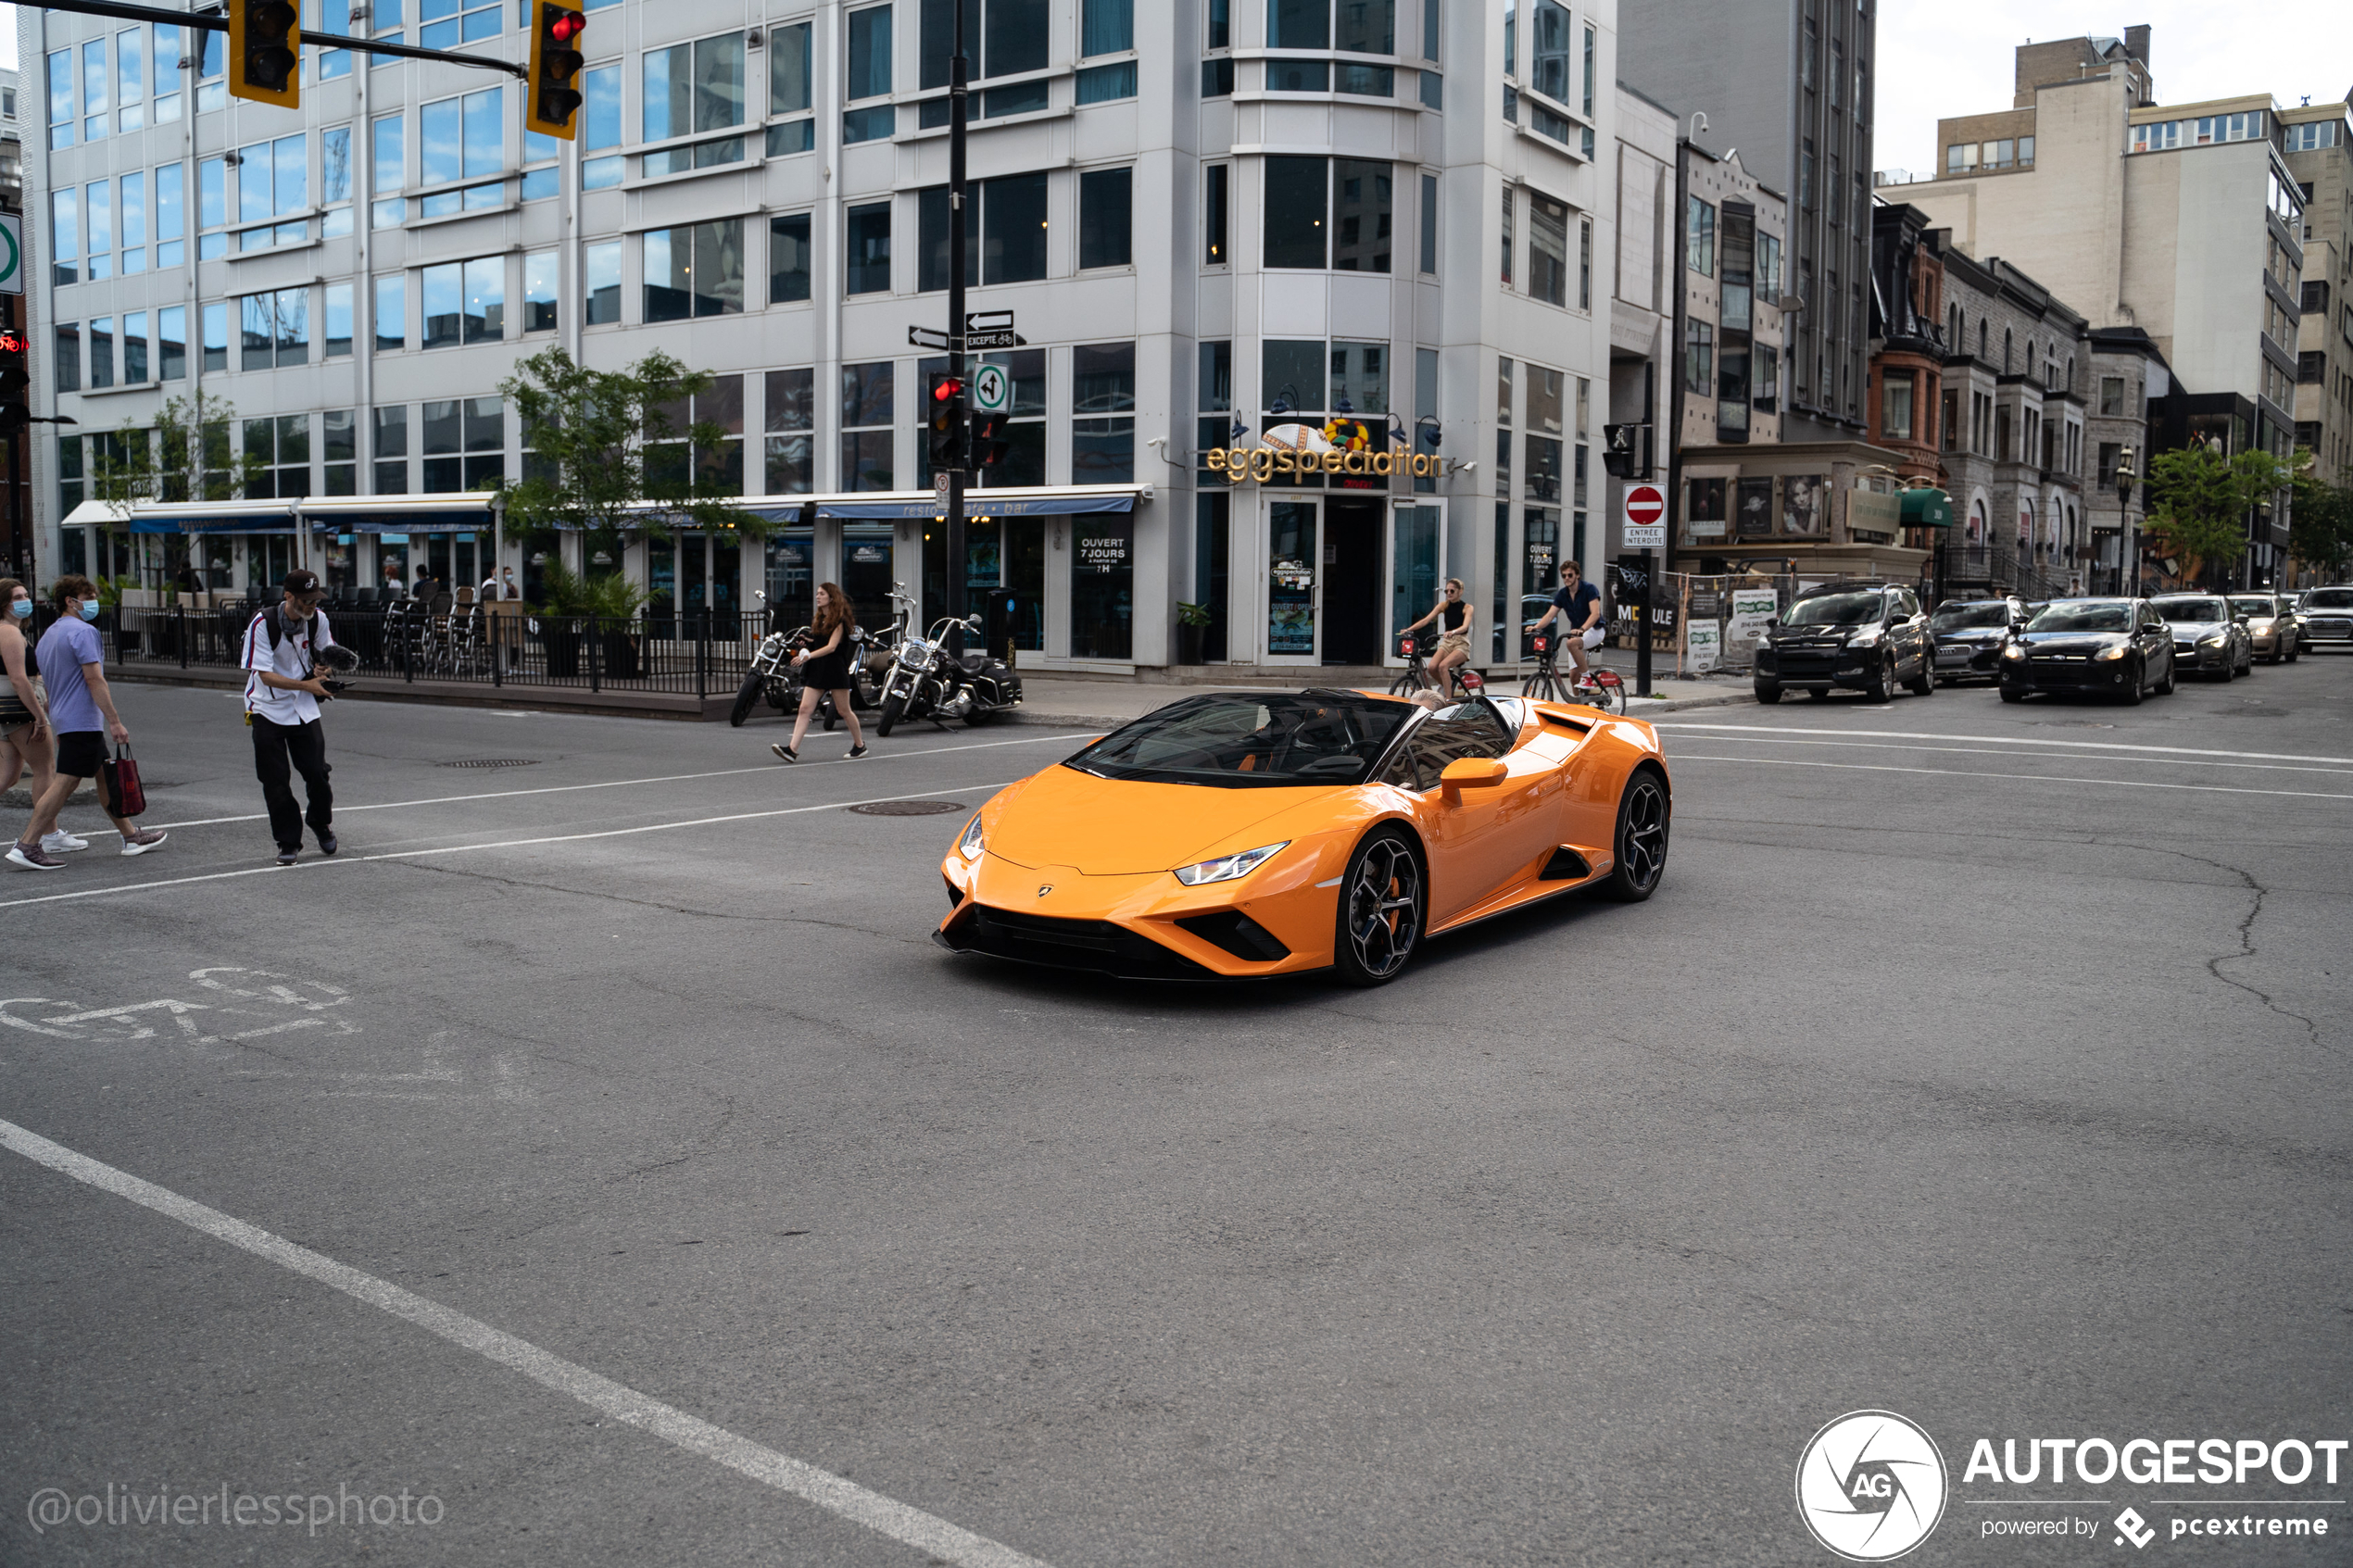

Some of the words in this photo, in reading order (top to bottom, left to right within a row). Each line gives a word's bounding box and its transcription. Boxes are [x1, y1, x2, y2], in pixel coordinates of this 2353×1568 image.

[1206, 444, 1442, 484] eggspectation
[903, 505, 937, 516] resto
[963, 502, 985, 515] afé
[1004, 502, 1029, 514] bar
[1082, 538, 1125, 547] OUVERT
[1080, 549, 1087, 558] 7
[1088, 549, 1126, 558] JOURS
[1529, 545, 1553, 554] OUVERT
[1102, 565, 1110, 573] H
[1617, 605, 1673, 625] MULE
